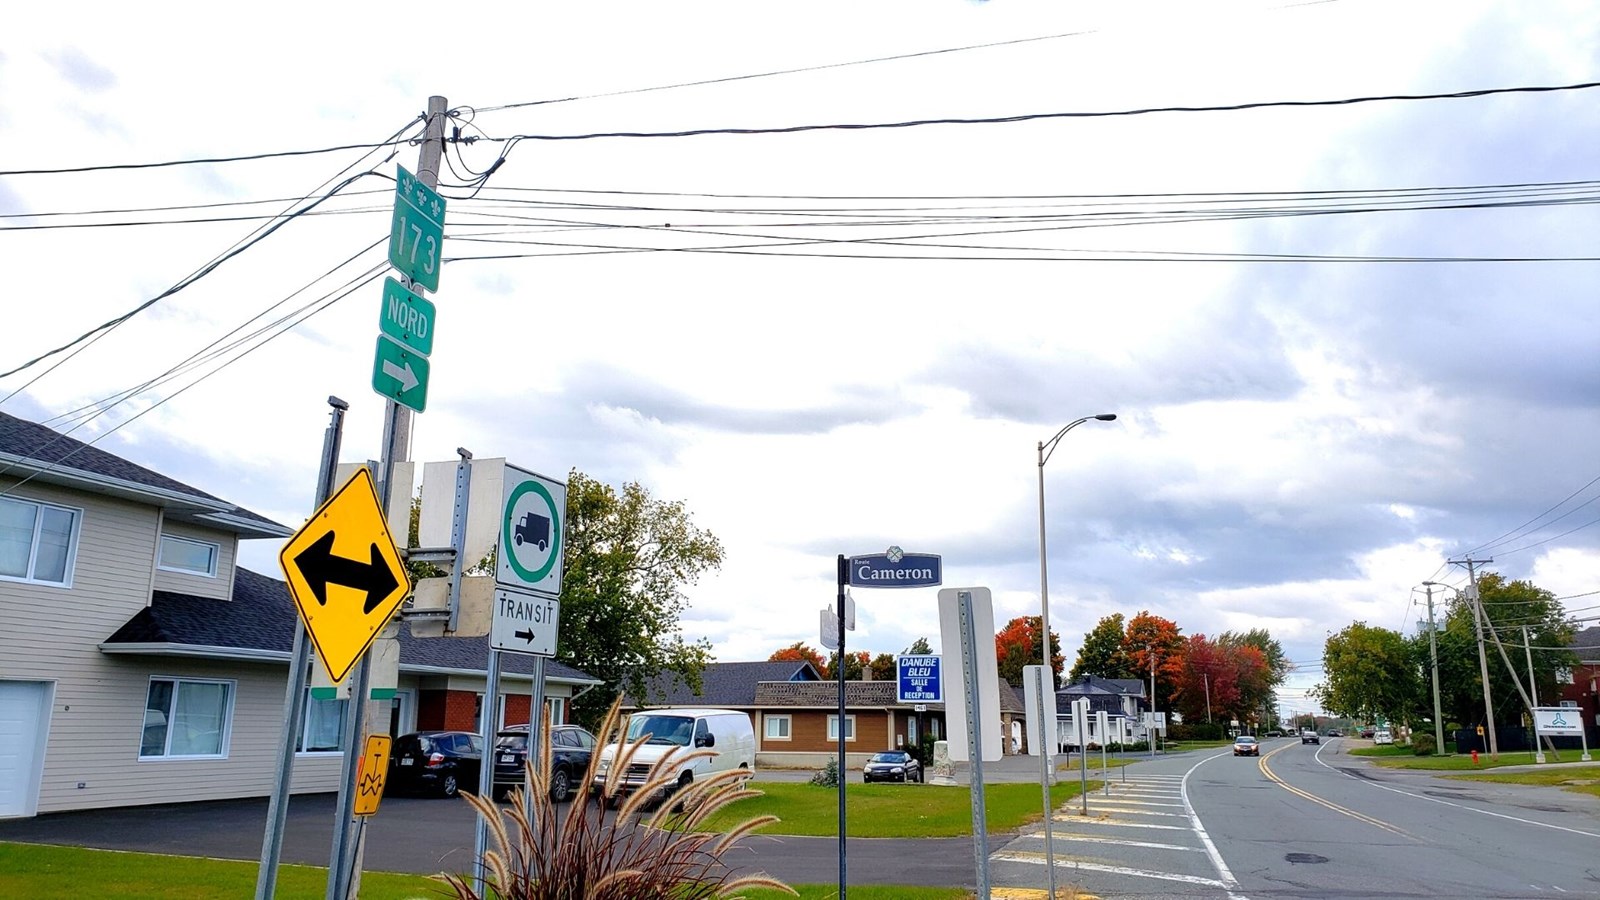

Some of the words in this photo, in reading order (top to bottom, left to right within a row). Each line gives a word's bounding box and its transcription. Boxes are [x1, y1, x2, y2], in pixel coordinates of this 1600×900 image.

[398, 215, 436, 274] 173
[387, 294, 427, 338] NORD
[858, 565, 933, 580] Cameron
[499, 597, 553, 624] TRANSIT
[901, 658, 937, 667] DANUBE
[907, 667, 931, 676] BLEU
